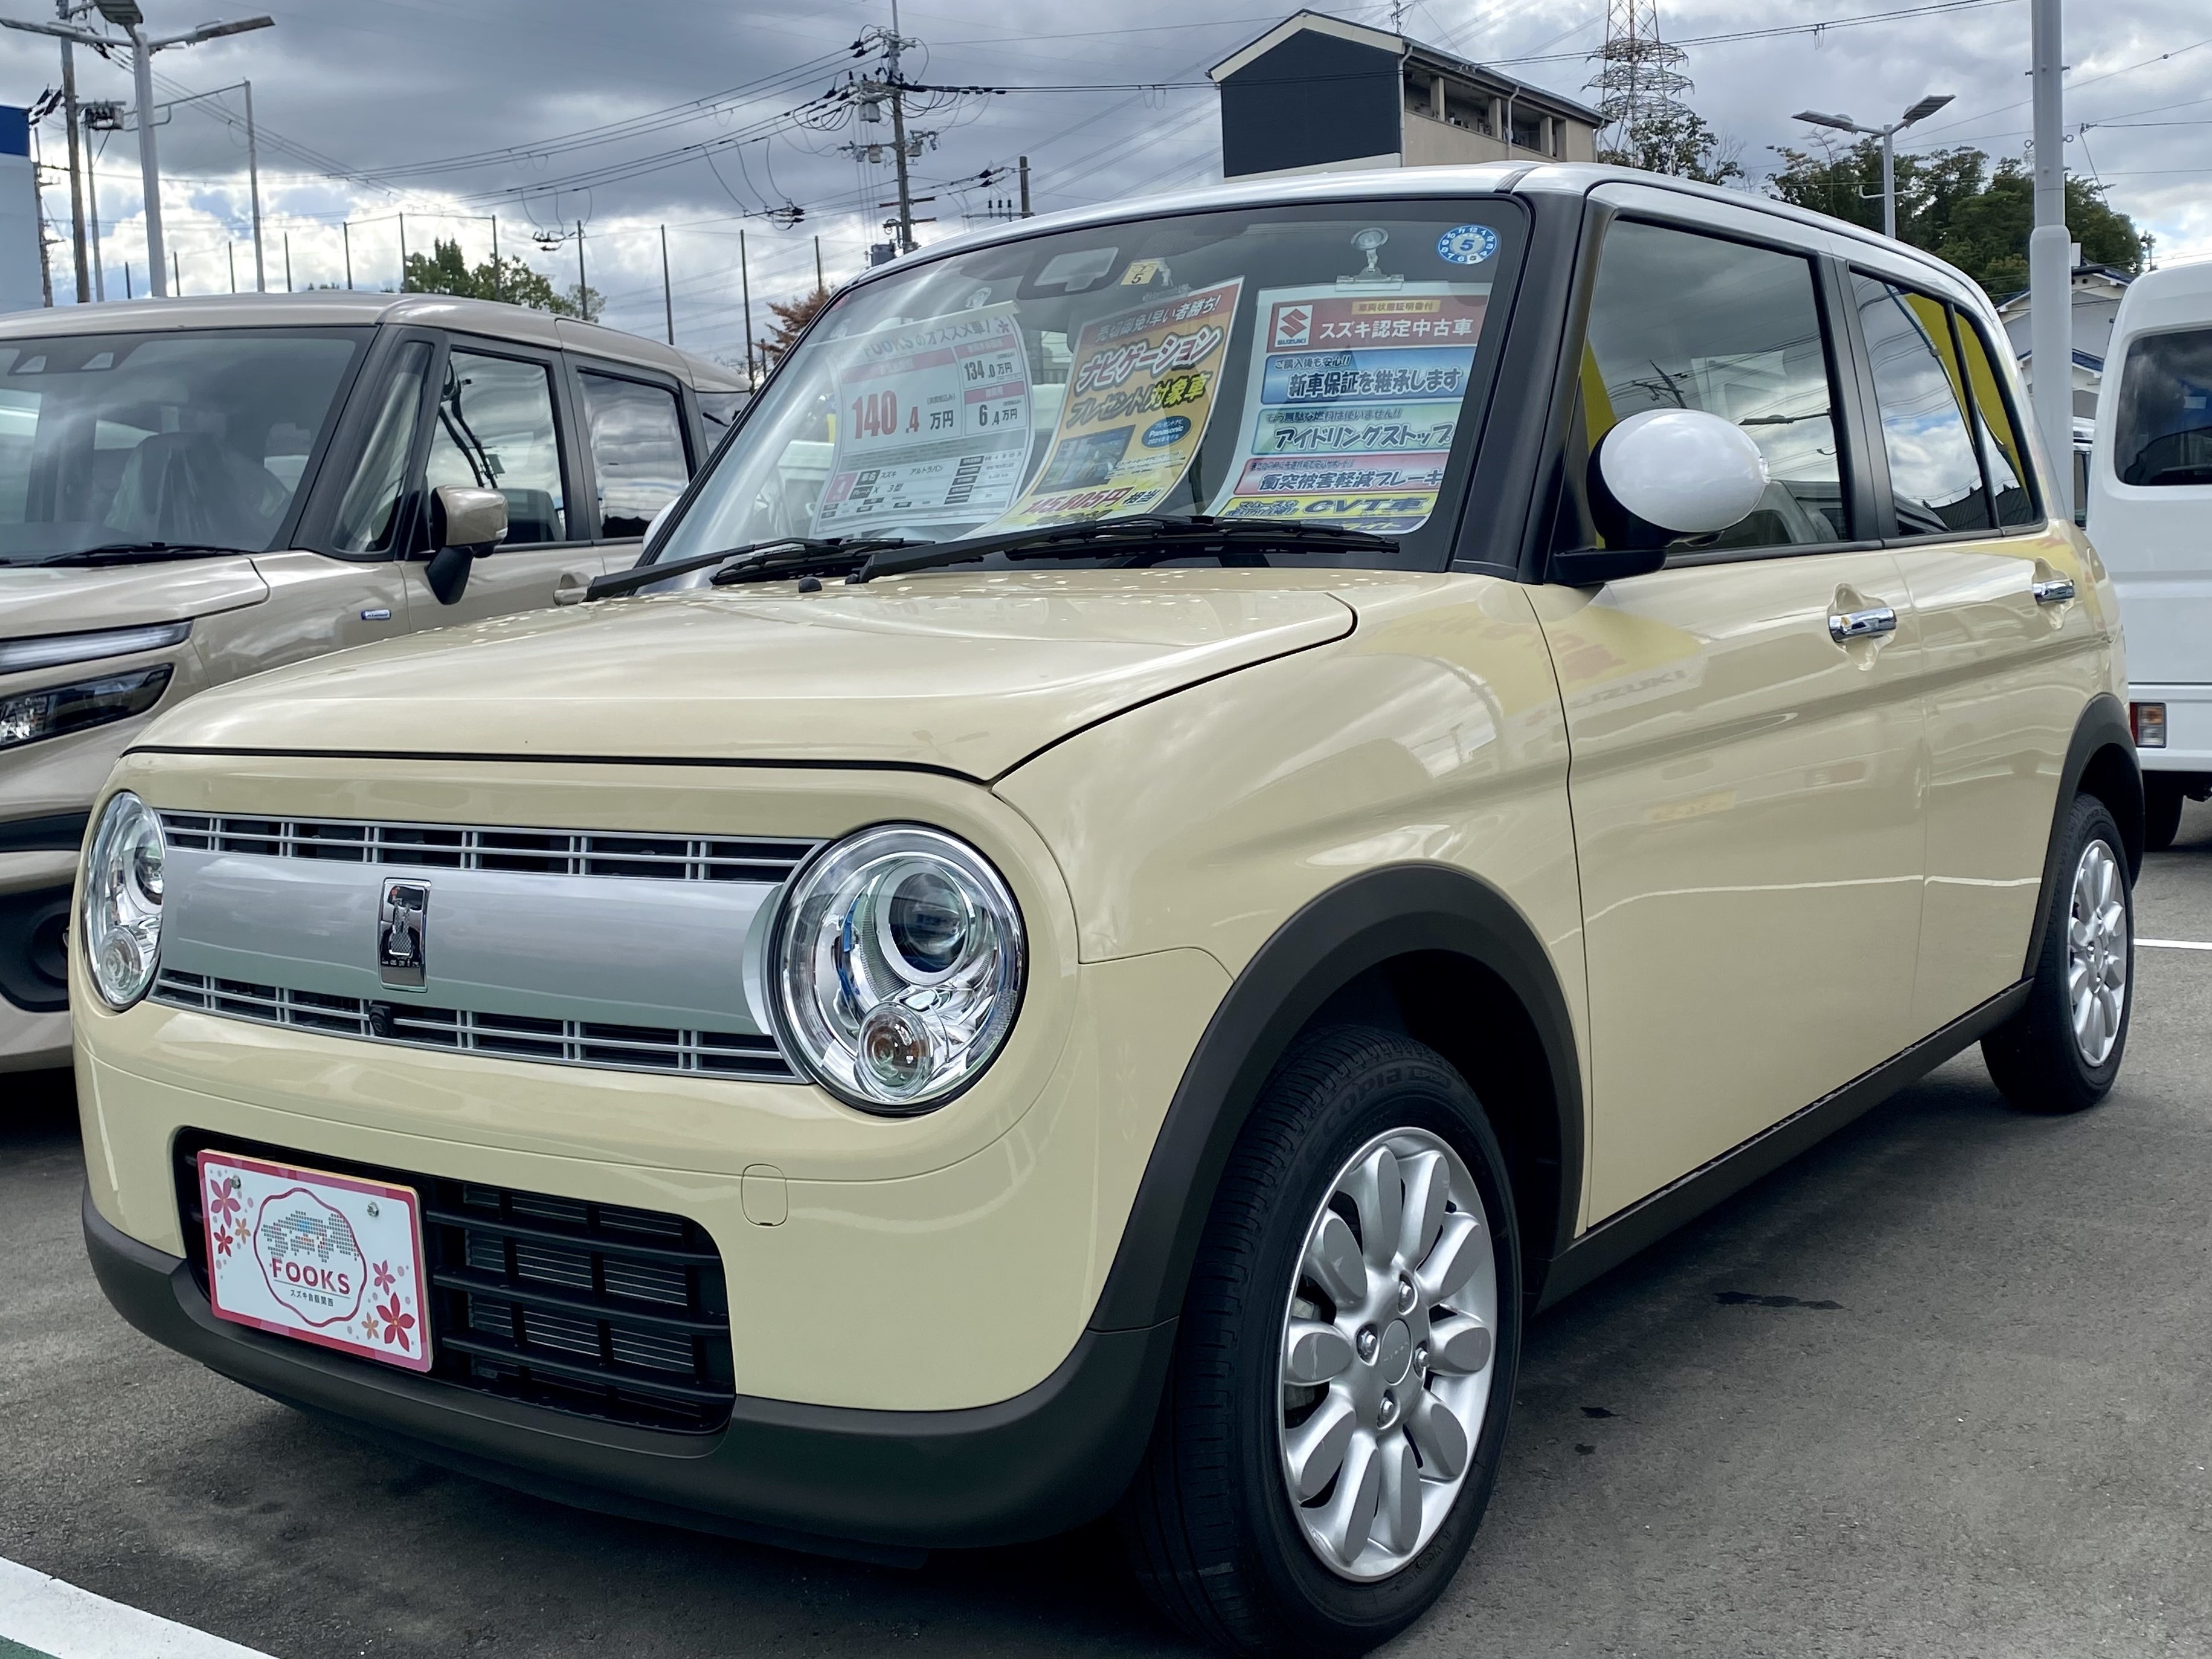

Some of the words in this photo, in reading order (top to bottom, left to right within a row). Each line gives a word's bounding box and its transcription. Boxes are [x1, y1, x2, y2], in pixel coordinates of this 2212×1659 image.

[1459, 239, 1474, 251] 5
[1131, 273, 1144, 284] 5
[1319, 318, 1473, 340] スズキ認定中古車
[1076, 327, 1222, 394] ナビゲーション
[1288, 369, 1462, 399] 新車保証を継承します
[930, 410, 953, 430] 万円
[1149, 425, 1184, 438] Panasonic
[1276, 424, 1455, 450] アイドリングストップ
[879, 470, 898, 479] スズキ
[909, 465, 944, 475] アルトラパン
[1259, 469, 1442, 491] 衝突被害軽減ブレーキ
[1304, 497, 1427, 514] CVT車
[272, 1257, 350, 1295] FOOKS
